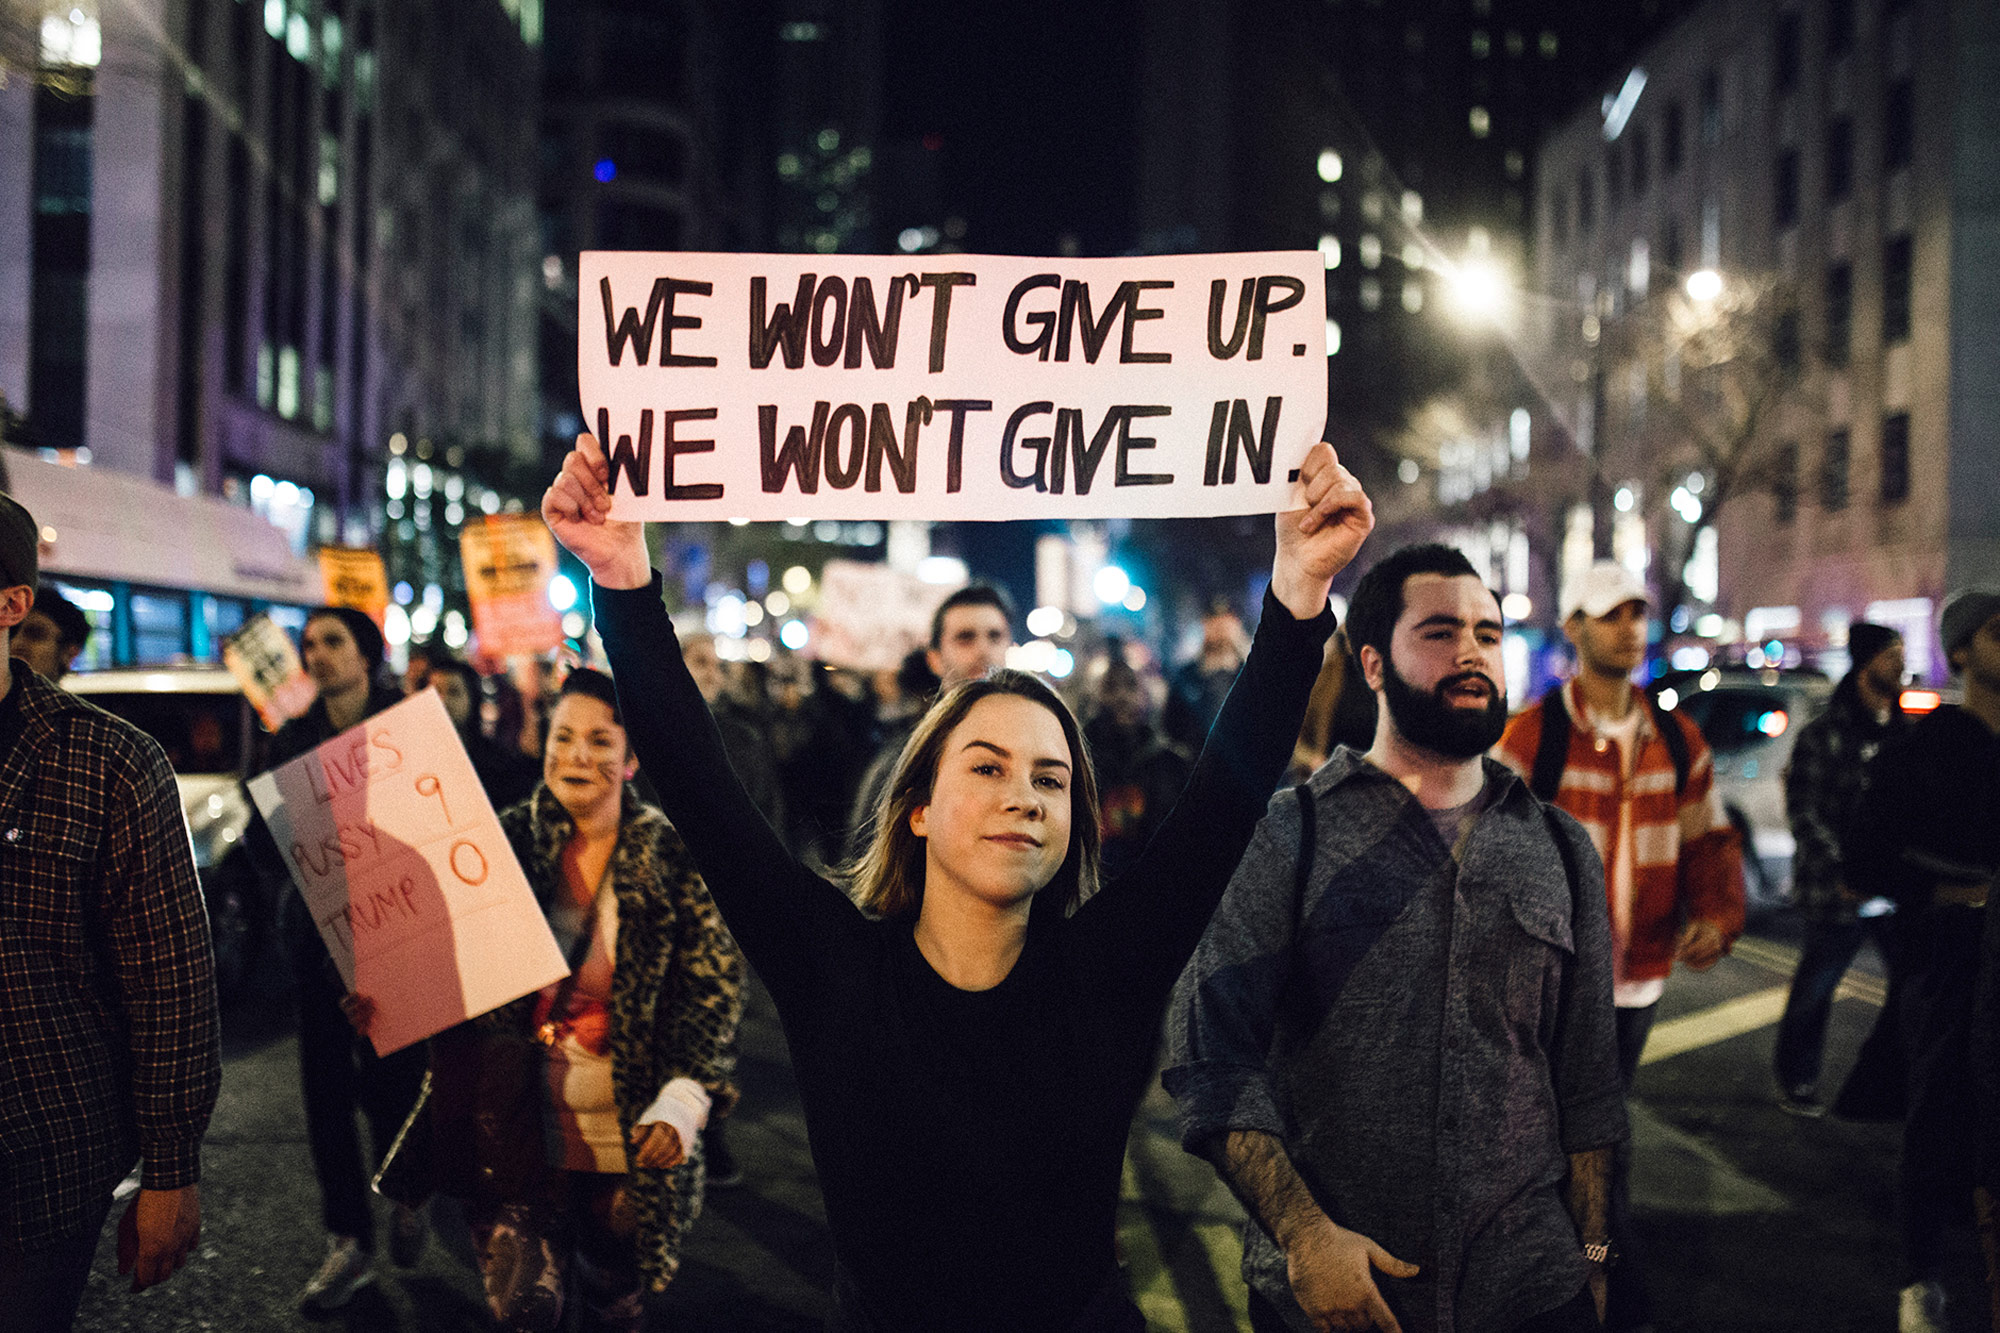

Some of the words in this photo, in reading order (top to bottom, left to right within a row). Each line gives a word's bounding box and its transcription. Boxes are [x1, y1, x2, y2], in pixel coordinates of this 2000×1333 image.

[600, 276, 717, 368] WE
[750, 272, 976, 374] WON'T
[1002, 273, 1175, 364] GIVE
[1207, 275, 1307, 361] UP.
[598, 407, 724, 500] WE
[758, 395, 992, 494] WON'T
[1000, 401, 1175, 496] GIVE
[1203, 396, 1301, 486] IN.
[302, 727, 403, 804] LIVES
[290, 817, 381, 885] PUSSY
[415, 775, 453, 827] 9
[321, 877, 417, 952] TRUMP
